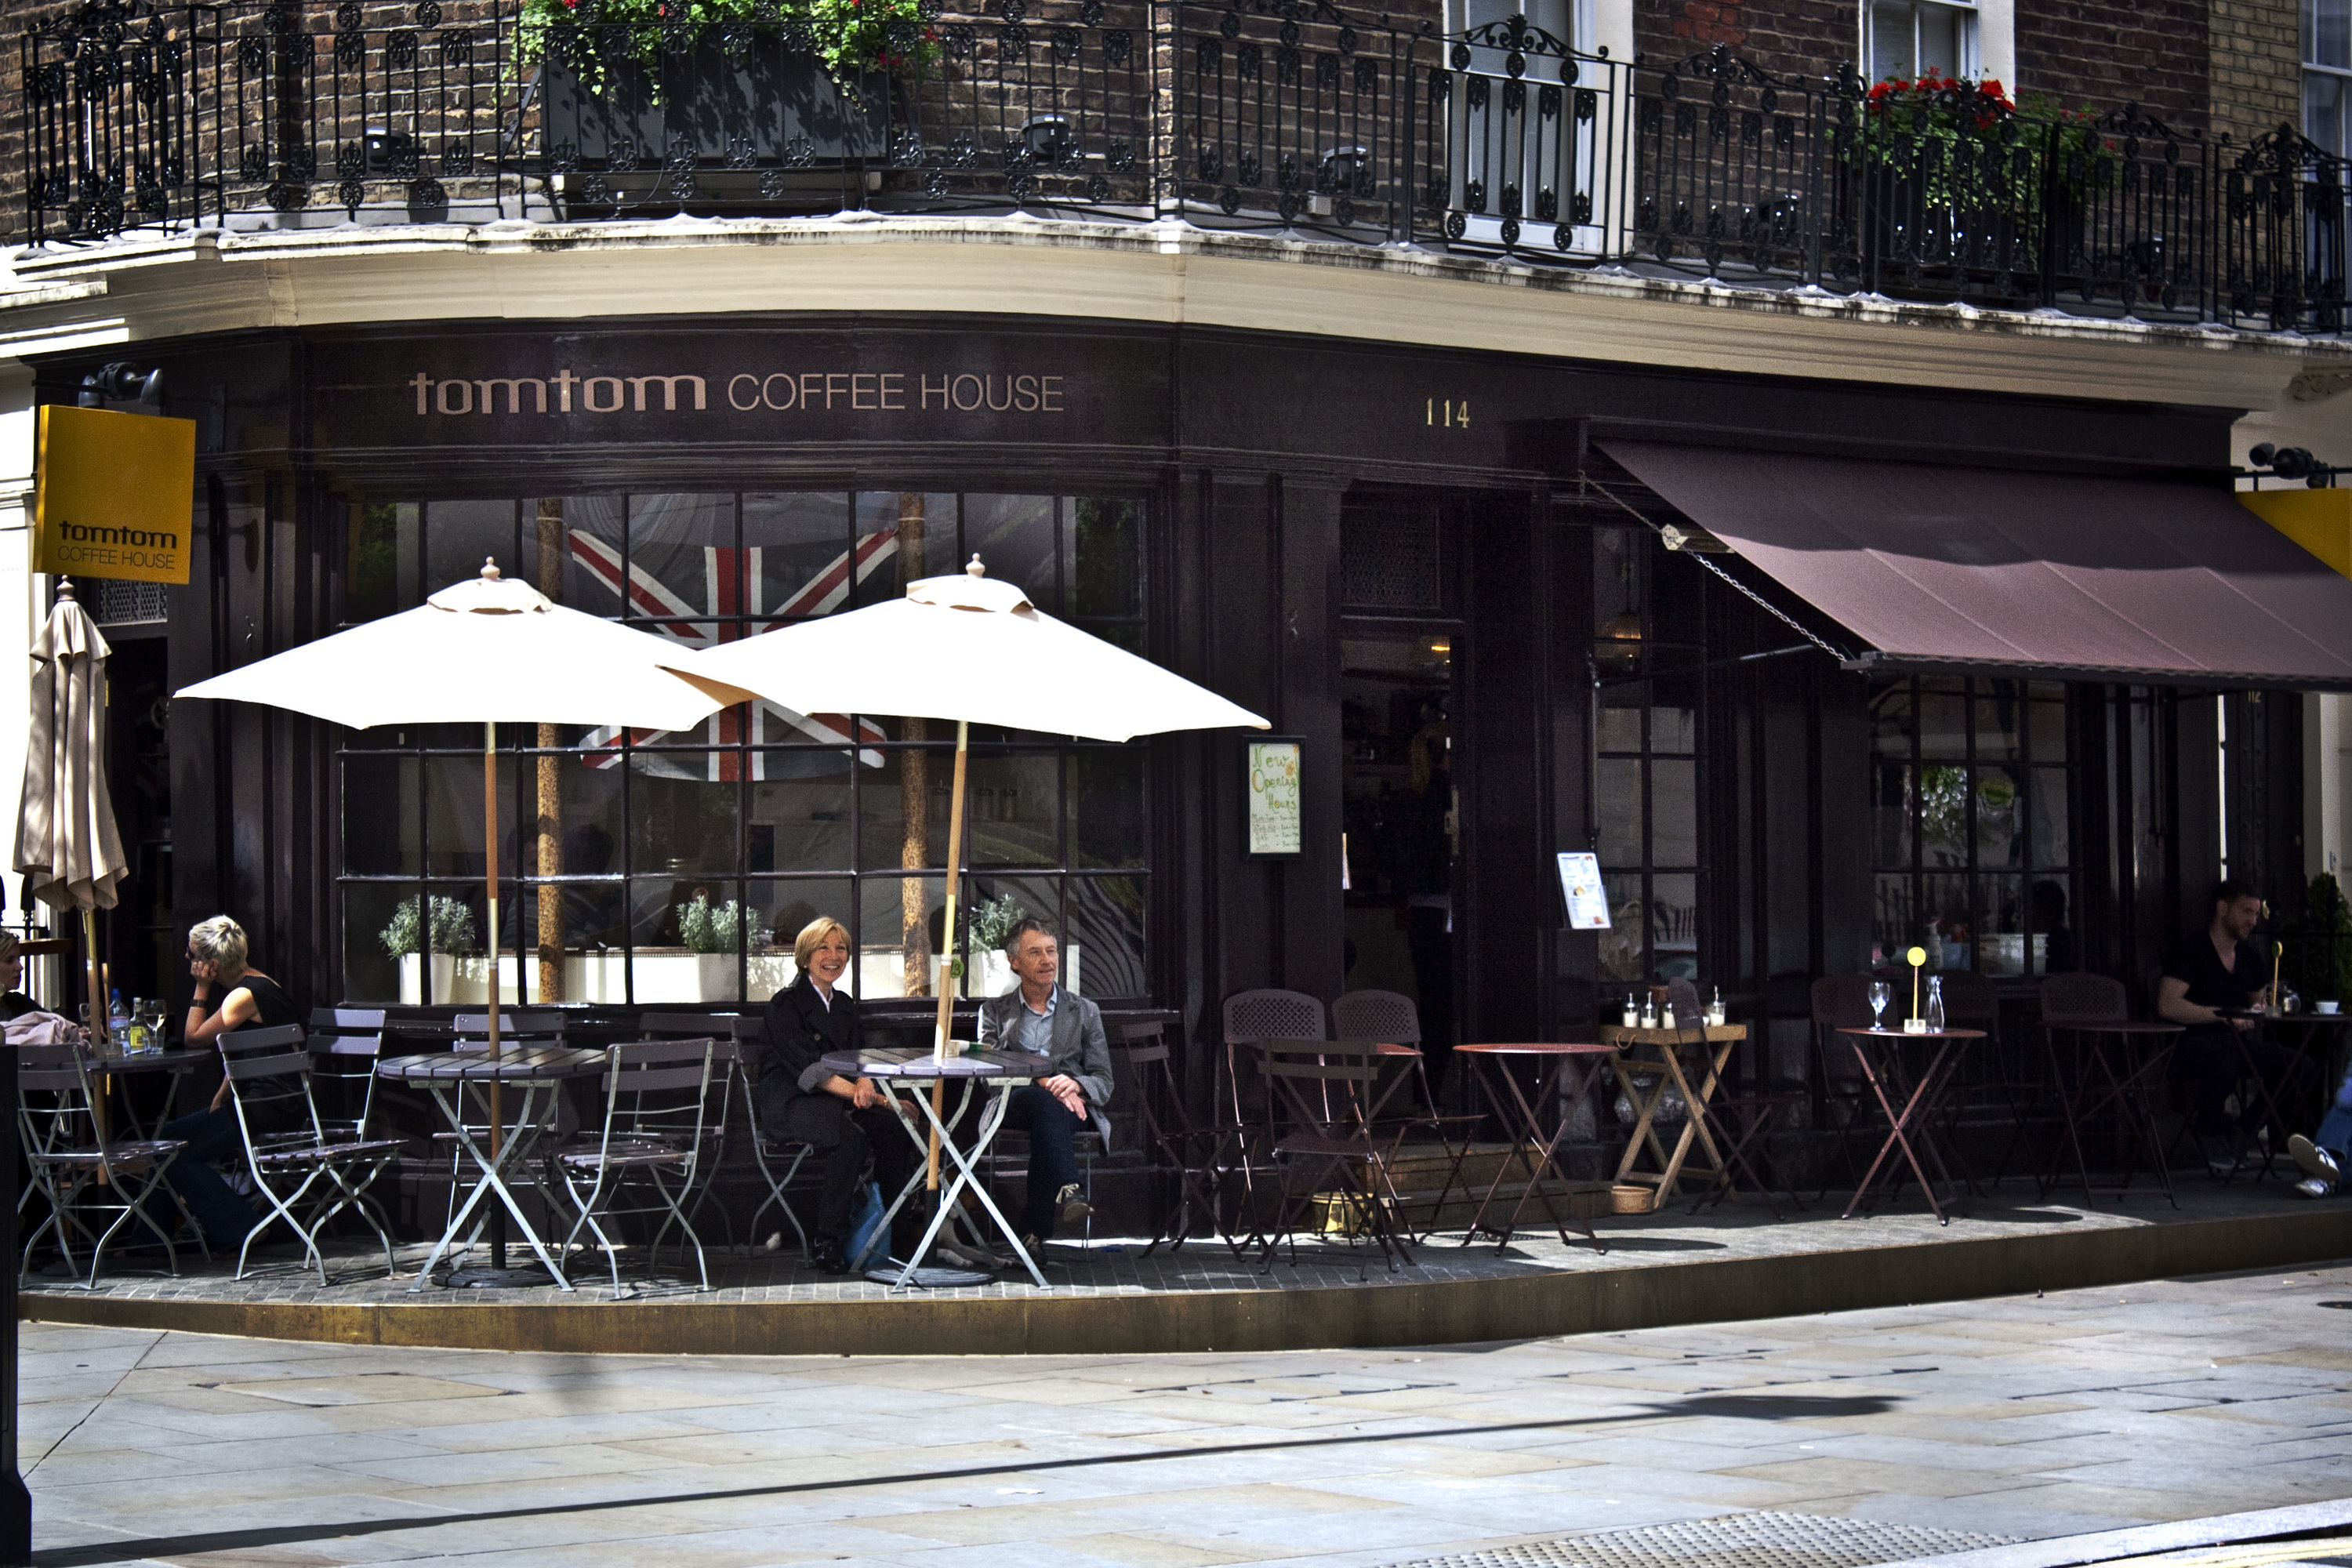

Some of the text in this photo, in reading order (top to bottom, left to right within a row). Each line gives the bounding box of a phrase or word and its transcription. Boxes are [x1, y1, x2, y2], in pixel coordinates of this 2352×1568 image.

[409, 369, 1064, 415] tomtom COFFEE HOUSE
[1427, 397, 1470, 428] 114
[59, 520, 177, 549] tomtom
[57, 546, 175, 570] COFFEE HOUSE
[1253, 744, 1290, 768] New
[1252, 768, 1297, 798] Opening
